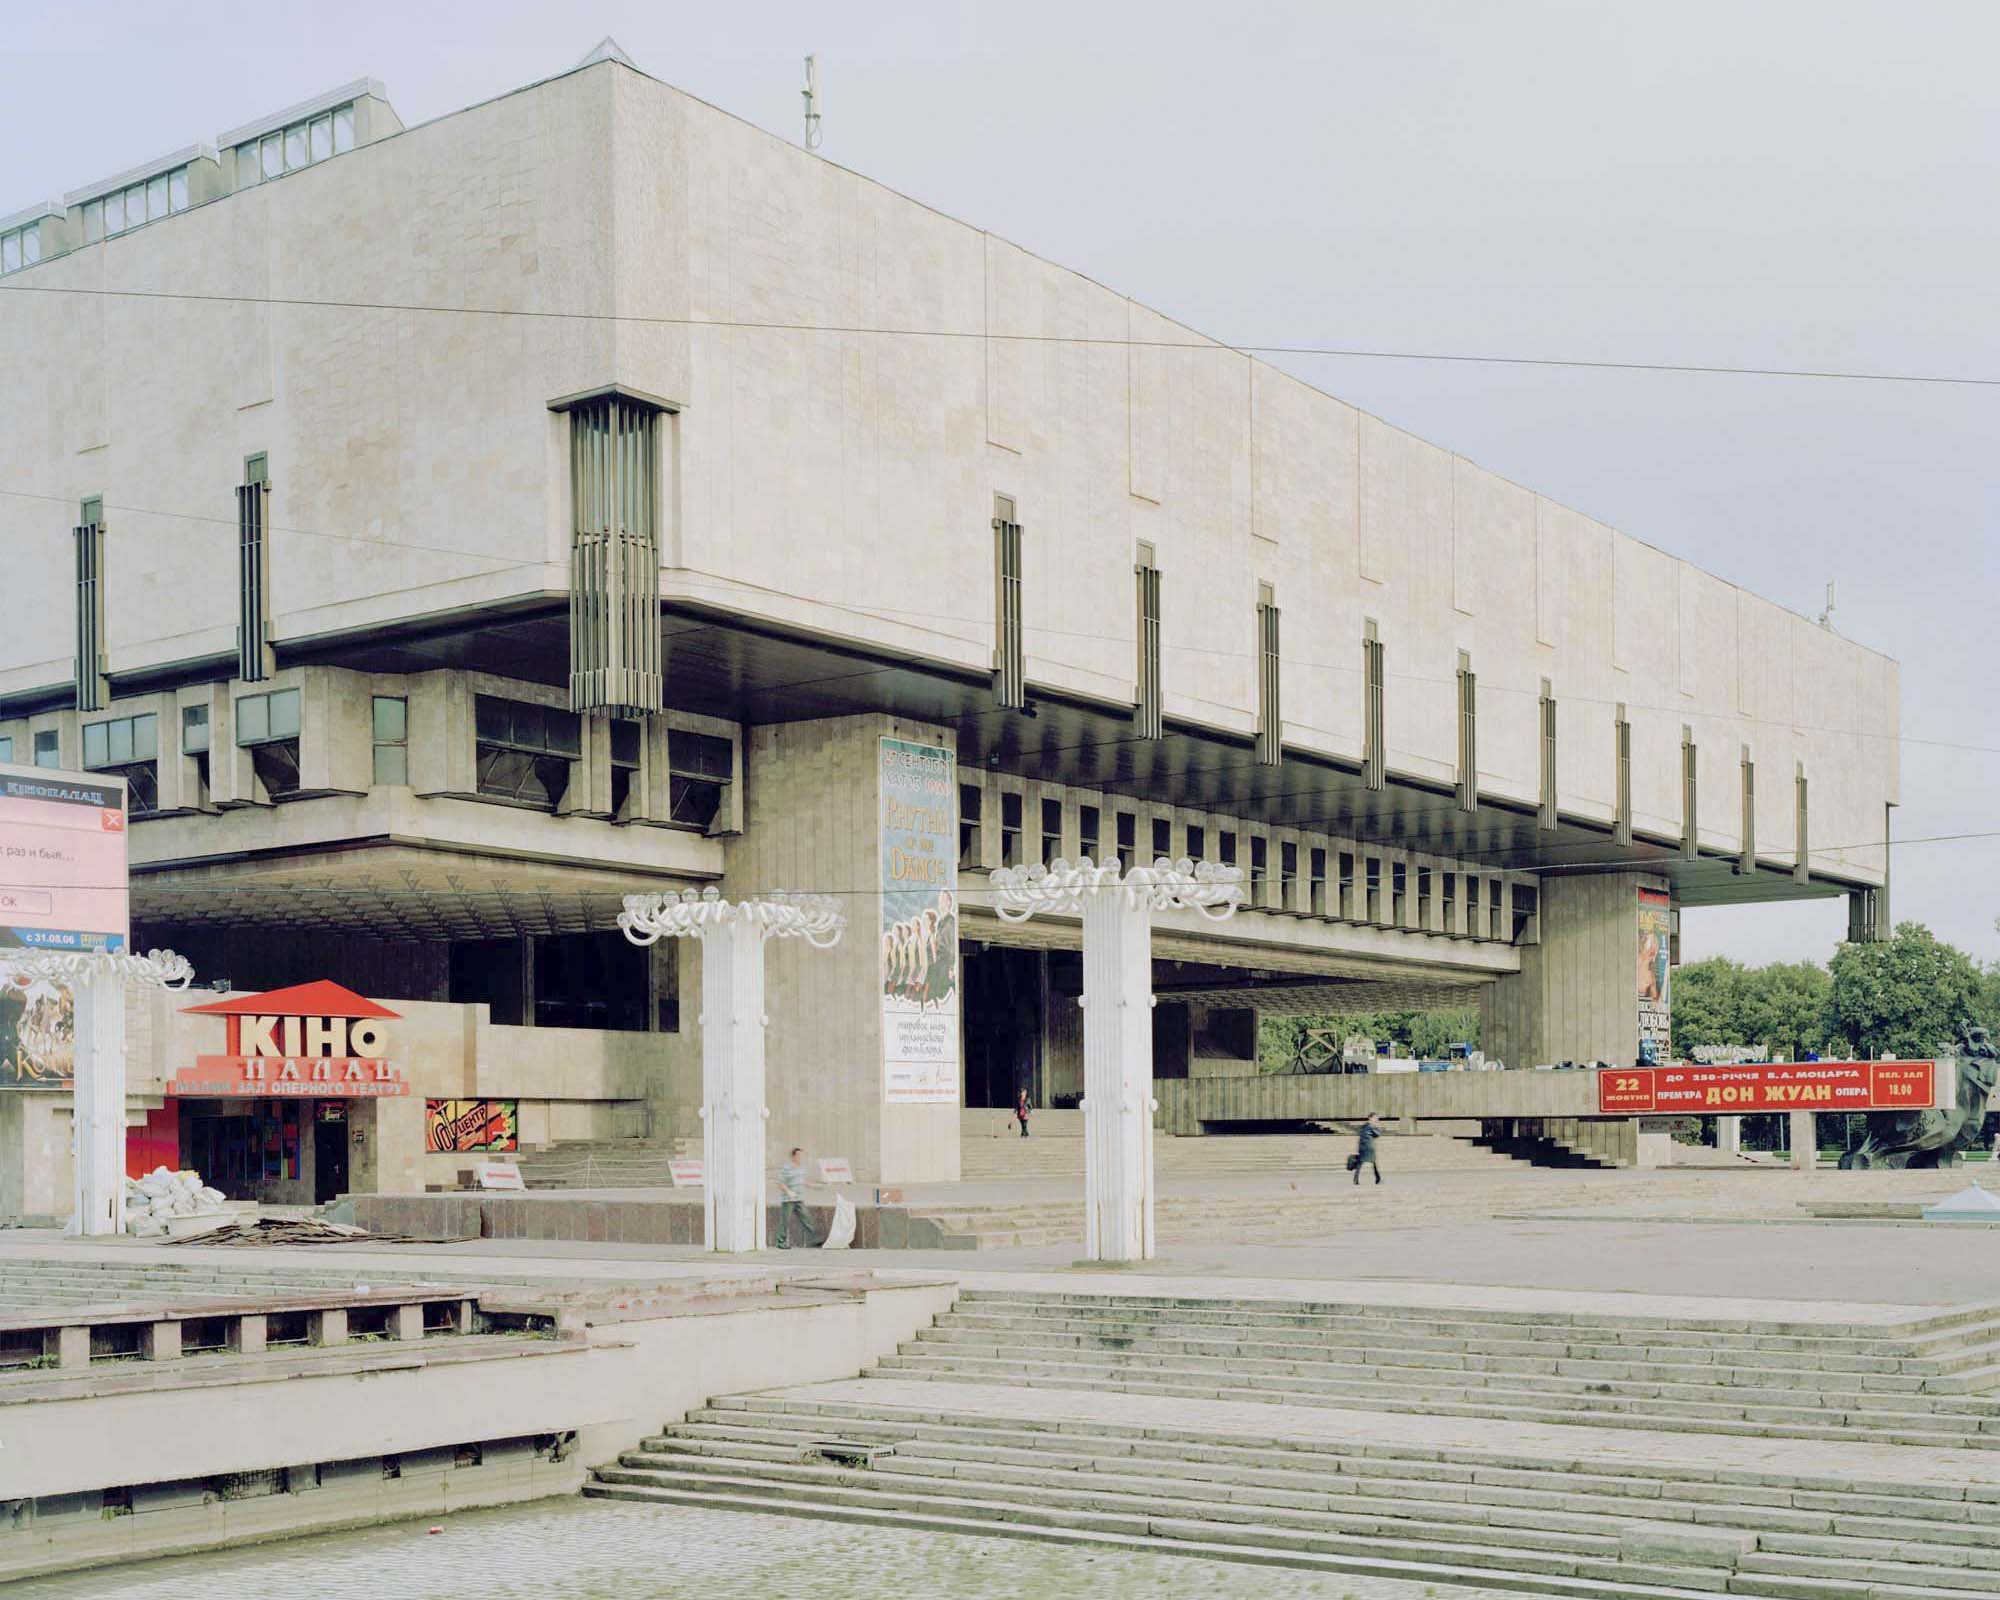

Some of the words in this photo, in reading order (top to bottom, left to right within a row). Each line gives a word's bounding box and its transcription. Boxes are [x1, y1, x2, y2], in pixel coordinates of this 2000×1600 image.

[7, 847, 26, 861] раз
[29, 848, 37, 857] и
[240, 1015, 389, 1058] КІНО
[245, 1058, 394, 1081] ПАЛАЦ
[1666, 1074, 1684, 1082] ДО
[1796, 1070, 1860, 1079] МОЦАРТА
[1903, 1071, 1924, 1079] ЗАЛ
[239, 1081, 265, 1094] ЗАЛ
[271, 1081, 345, 1095] ОПЕРНОГО
[1616, 1078, 1640, 1091] 22
[1706, 1086, 1755, 1104] ДОН
[1764, 1085, 1832, 1101] ЖУАН
[1835, 1087, 1869, 1096] ОПЕРА
[458, 1107, 485, 1134] ЦЕНТР
